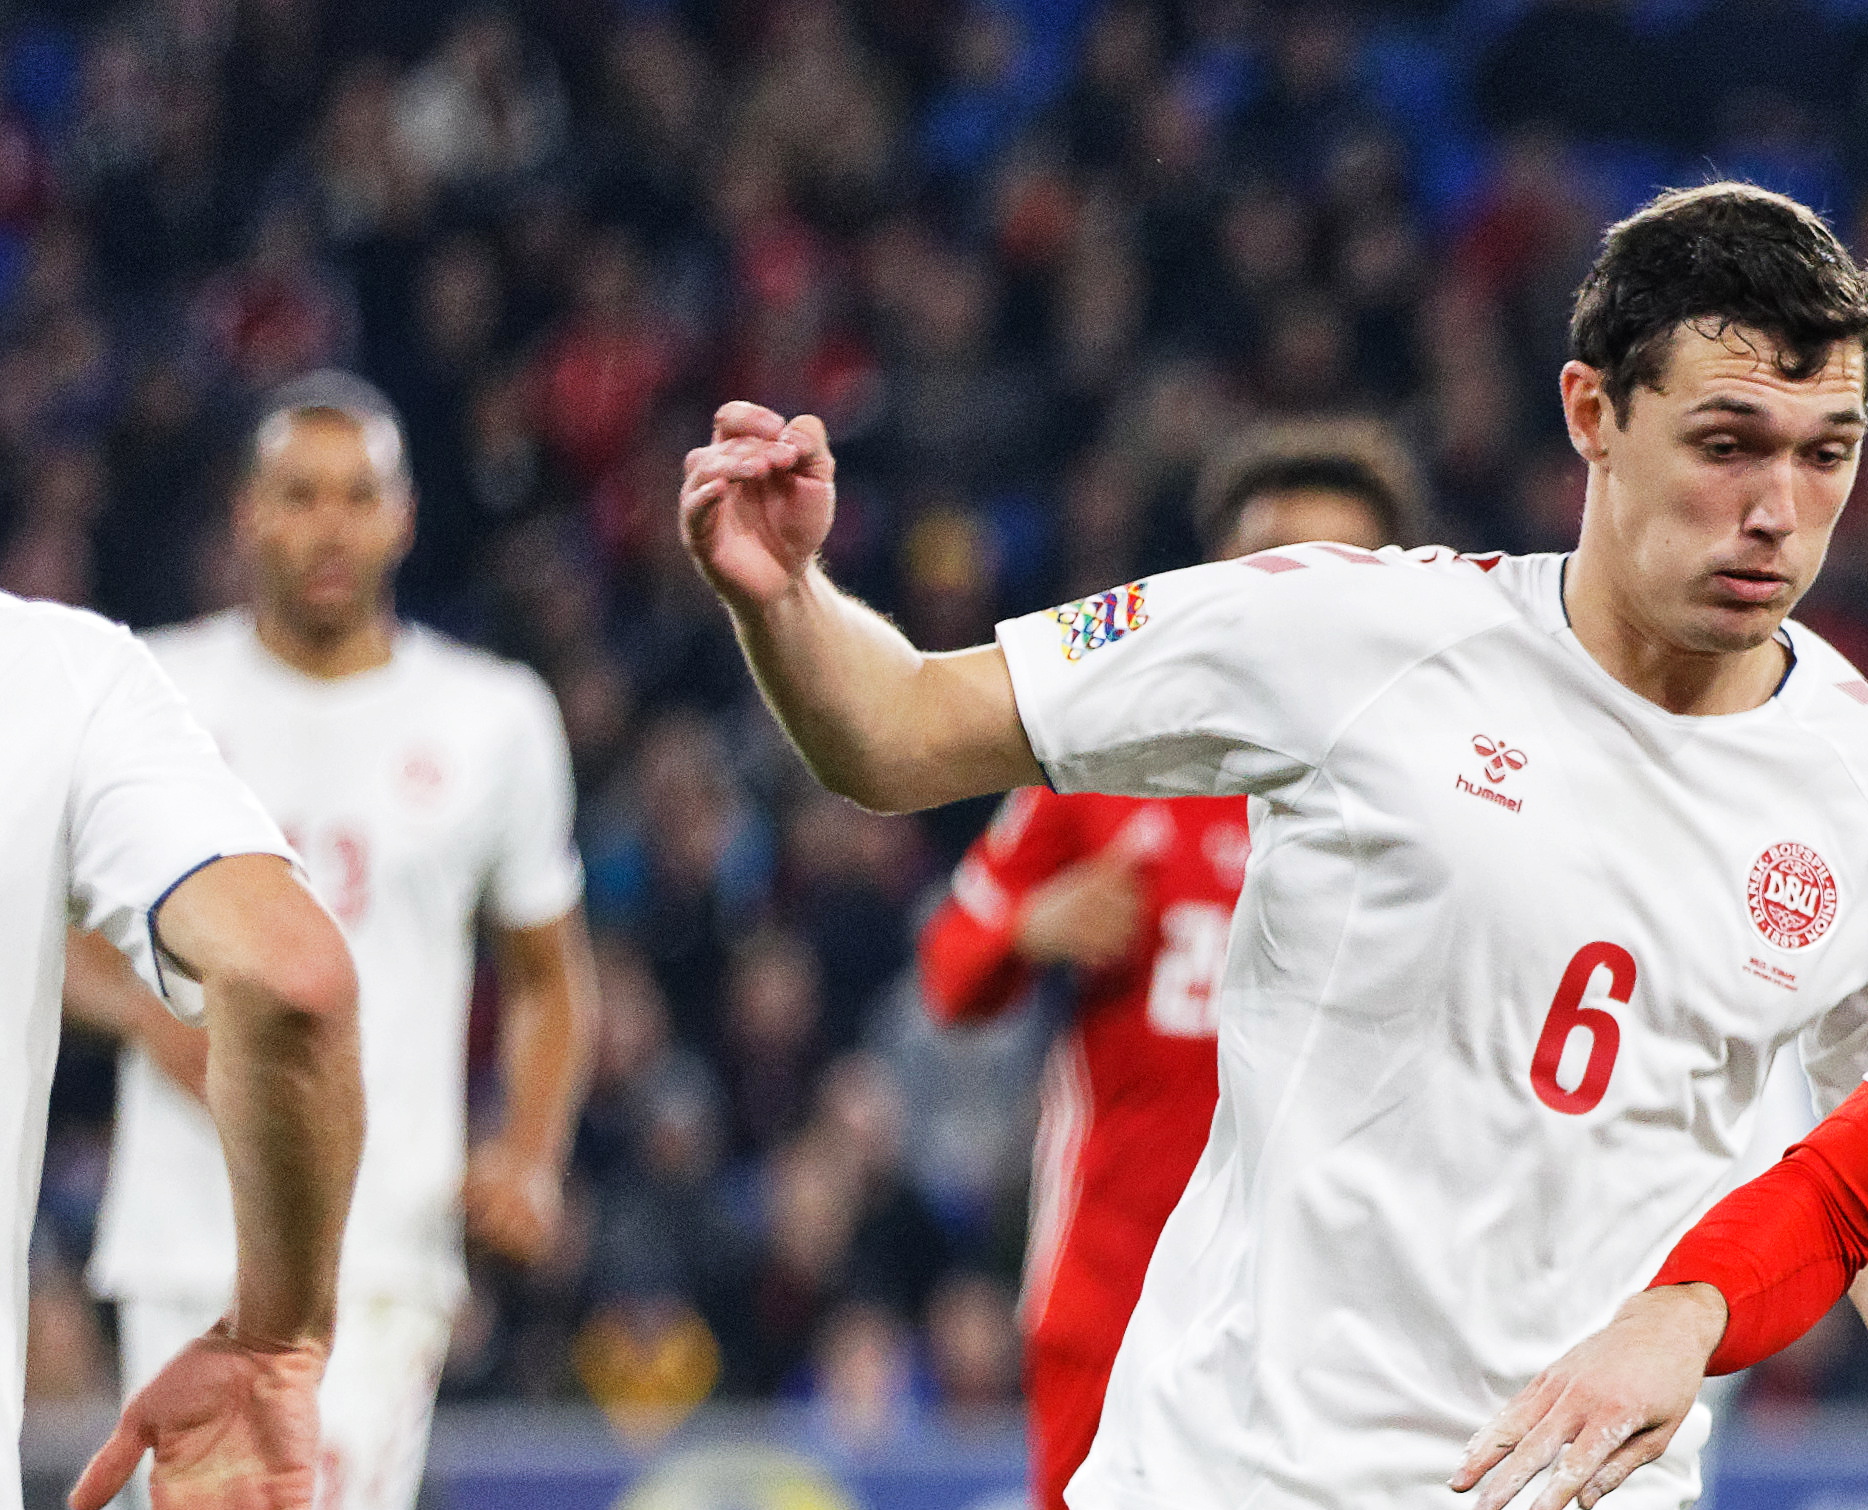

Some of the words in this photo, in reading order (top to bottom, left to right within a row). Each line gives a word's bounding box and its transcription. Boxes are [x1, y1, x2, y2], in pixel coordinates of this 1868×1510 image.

[1455, 773, 1523, 814] hummel
[1763, 869, 1820, 919] DBU
[1530, 940, 1637, 1116] 6
